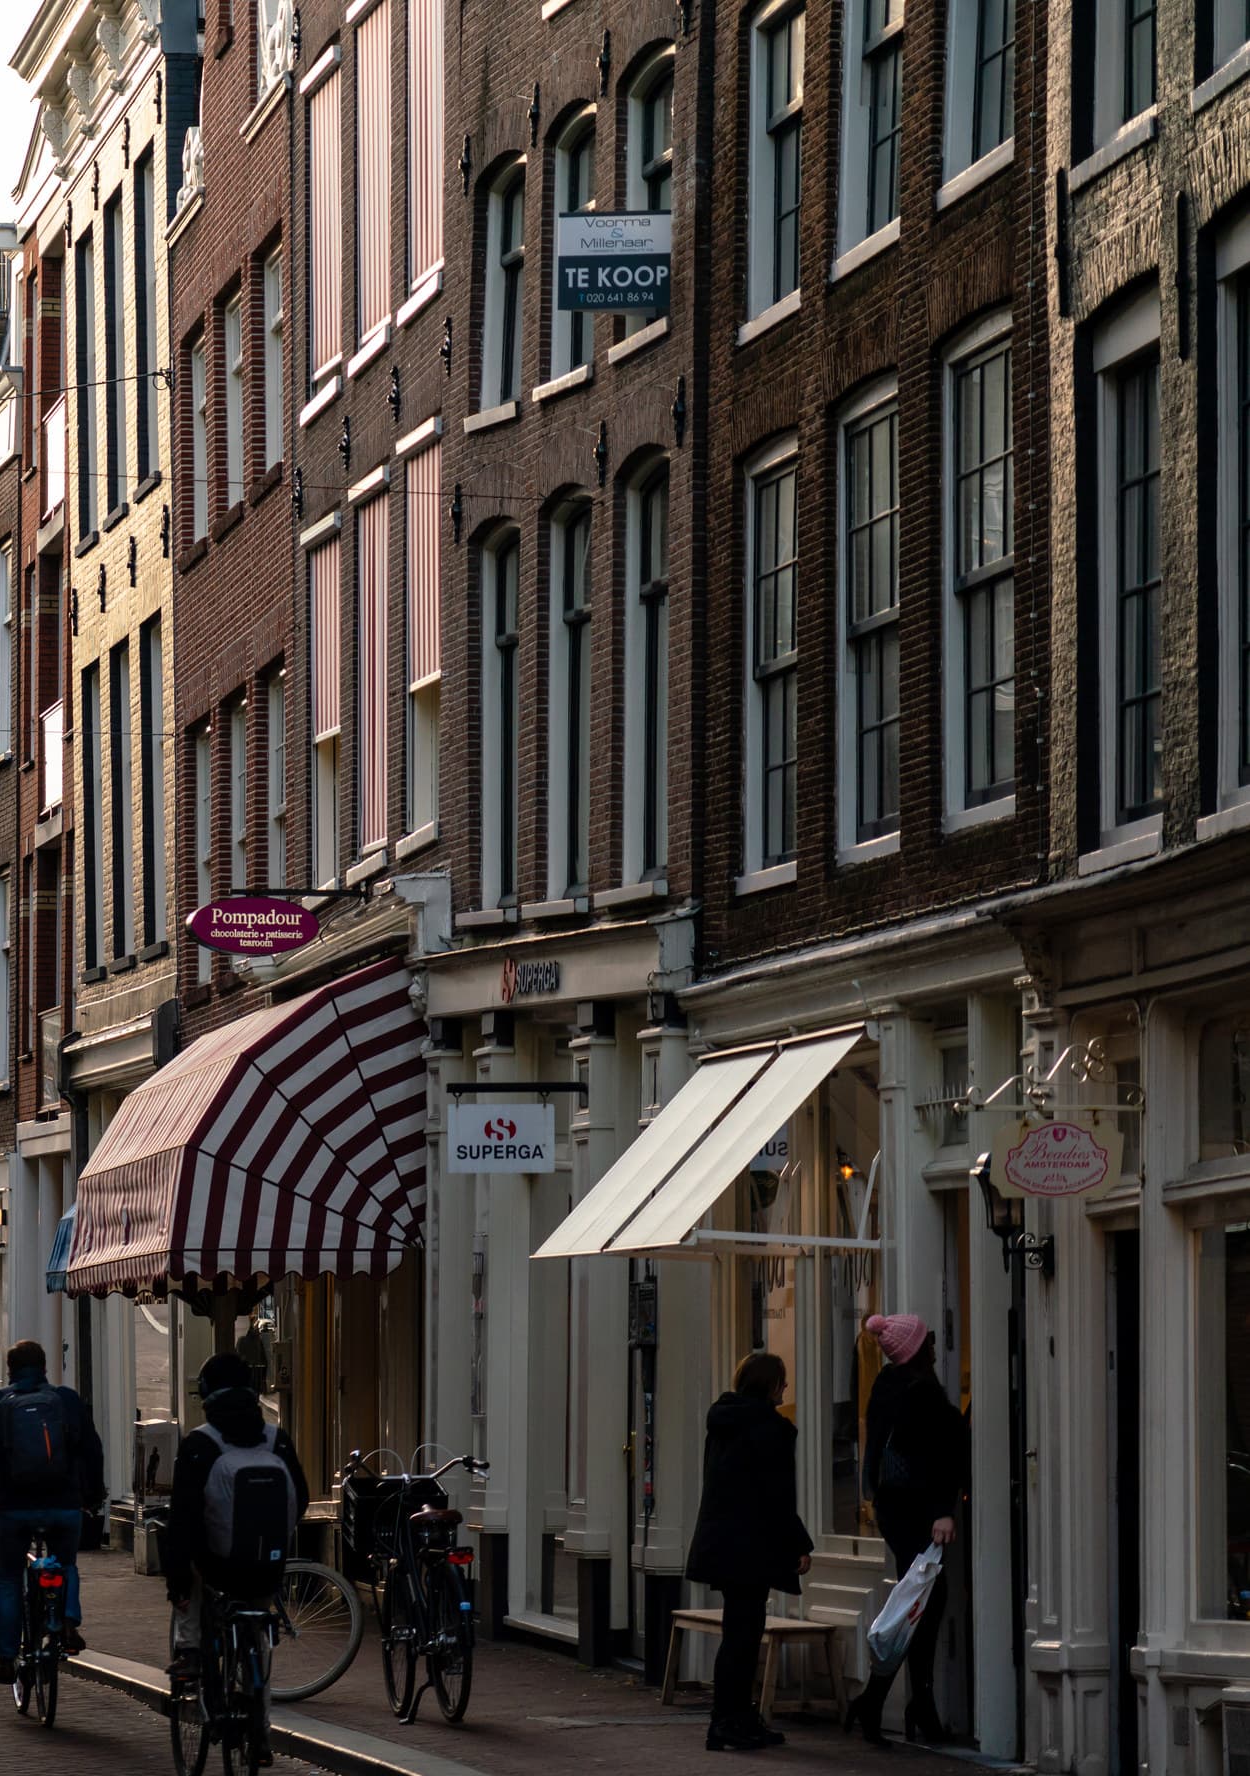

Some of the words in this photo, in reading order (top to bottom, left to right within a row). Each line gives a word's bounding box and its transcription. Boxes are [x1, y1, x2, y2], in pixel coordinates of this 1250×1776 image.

[584, 217, 651, 228] Voorma
[580, 238, 654, 249] Millenaar
[565, 267, 589, 288] TE
[597, 265, 668, 288] KOOP
[586, 293, 605, 303] 020
[607, 292, 624, 302] 641
[627, 292, 639, 302] 86
[641, 292, 654, 301] 94
[211, 908, 303, 928] Pompadour
[210, 928, 259, 938] chocolaterie
[265, 929, 303, 940] patisserie
[239, 938, 273, 947] tearoom
[515, 961, 556, 993] SUPERGA
[456, 1144, 544, 1159] SUPERGA
[1024, 1161, 1090, 1169] AMSTERDAM
